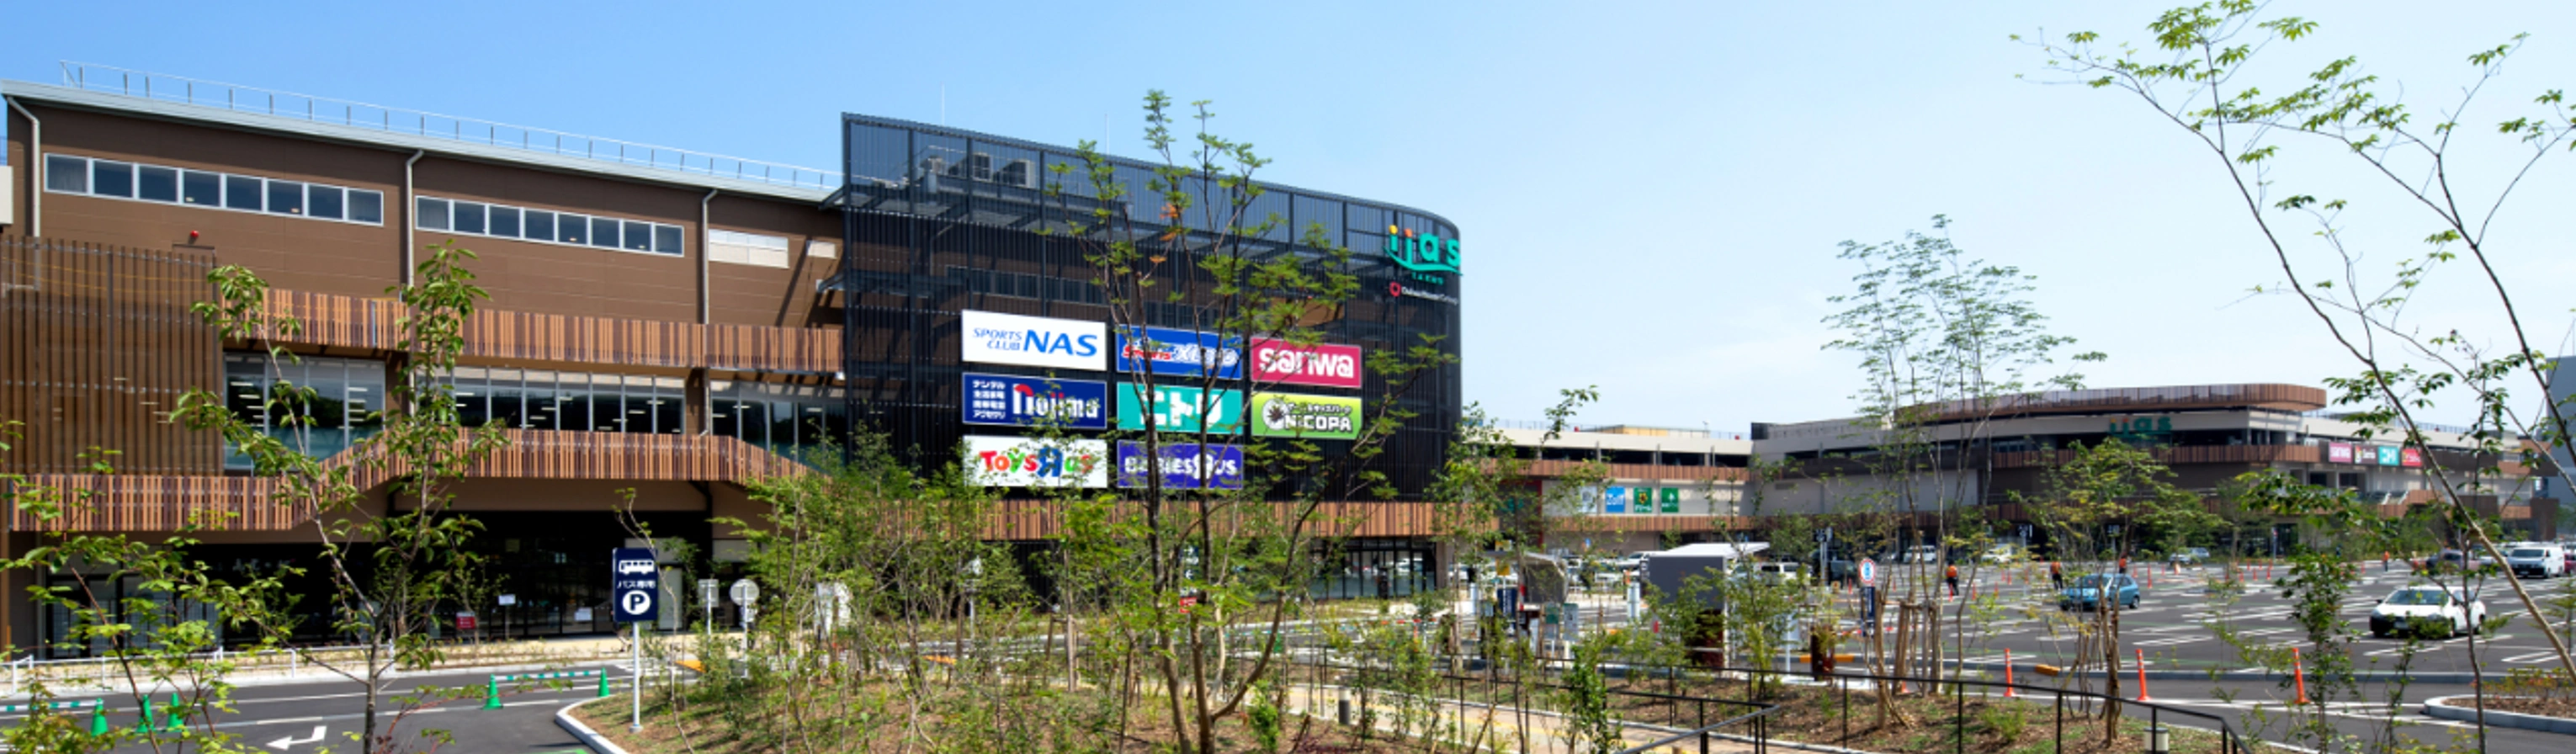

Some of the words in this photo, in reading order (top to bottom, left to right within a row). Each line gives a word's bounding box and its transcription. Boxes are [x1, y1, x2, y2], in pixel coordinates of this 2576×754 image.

[974, 328, 1022, 340] SPORTS
[987, 340, 1021, 351] CLUB
[1023, 329, 1097, 357] NAS
[1259, 348, 1354, 379] sanwa
[1140, 390, 1223, 427] ニトリ
